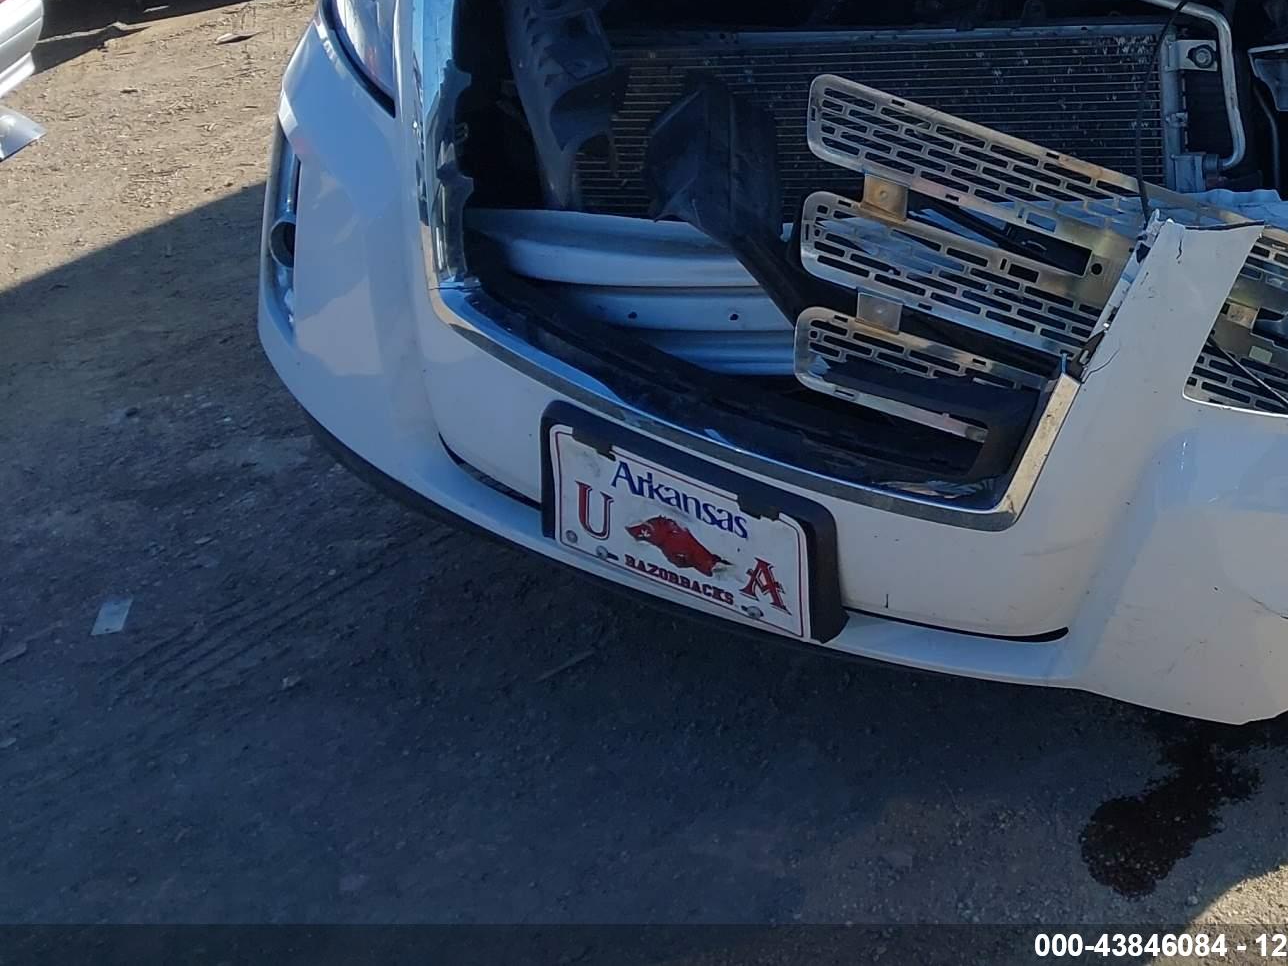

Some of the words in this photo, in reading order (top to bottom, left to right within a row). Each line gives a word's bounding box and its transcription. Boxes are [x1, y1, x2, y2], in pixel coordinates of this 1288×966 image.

[575, 481, 614, 541] U
[611, 460, 748, 539] Arkansas
[624, 554, 735, 606] RAZORBACKS
[739, 557, 792, 616] A
